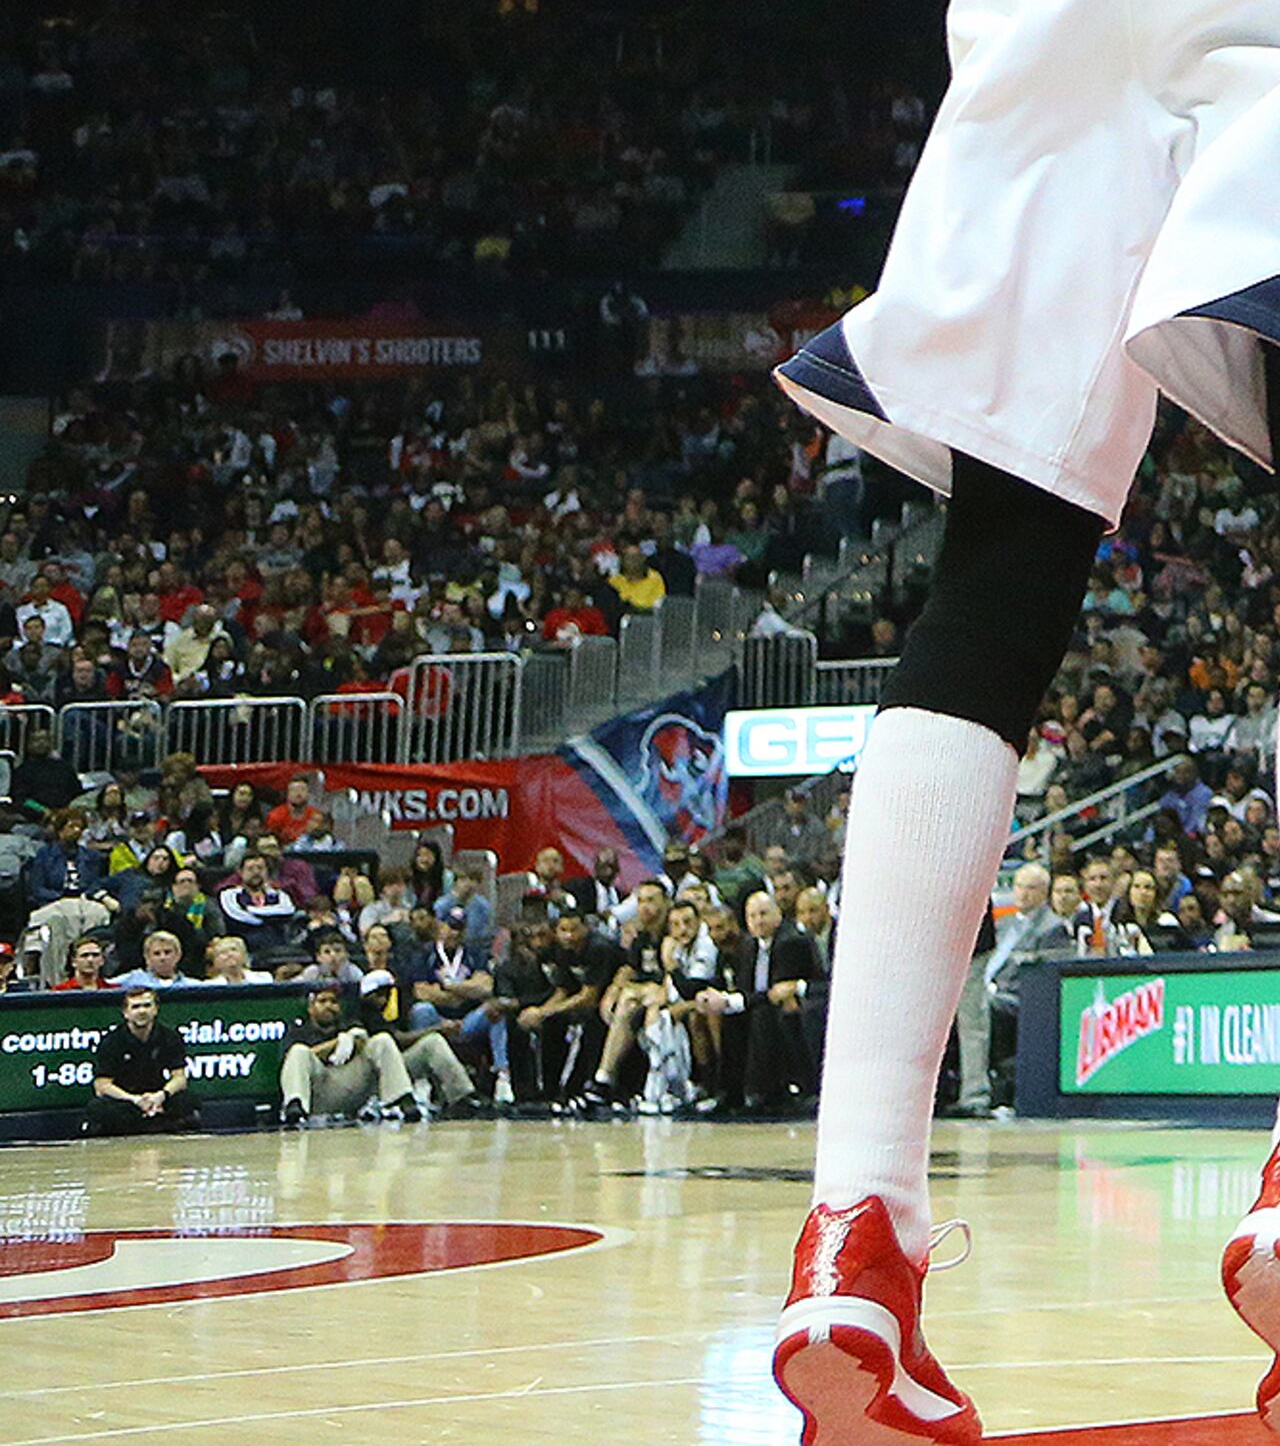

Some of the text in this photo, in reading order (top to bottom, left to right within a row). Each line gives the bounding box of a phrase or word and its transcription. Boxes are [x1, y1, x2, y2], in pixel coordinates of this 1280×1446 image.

[262, 335, 483, 367] SHELVIN'S SHOOTERS
[737, 713, 873, 767] GE
[360, 787, 508, 821] WKS.COM
[1076, 977, 1165, 1087] LIBMAN
